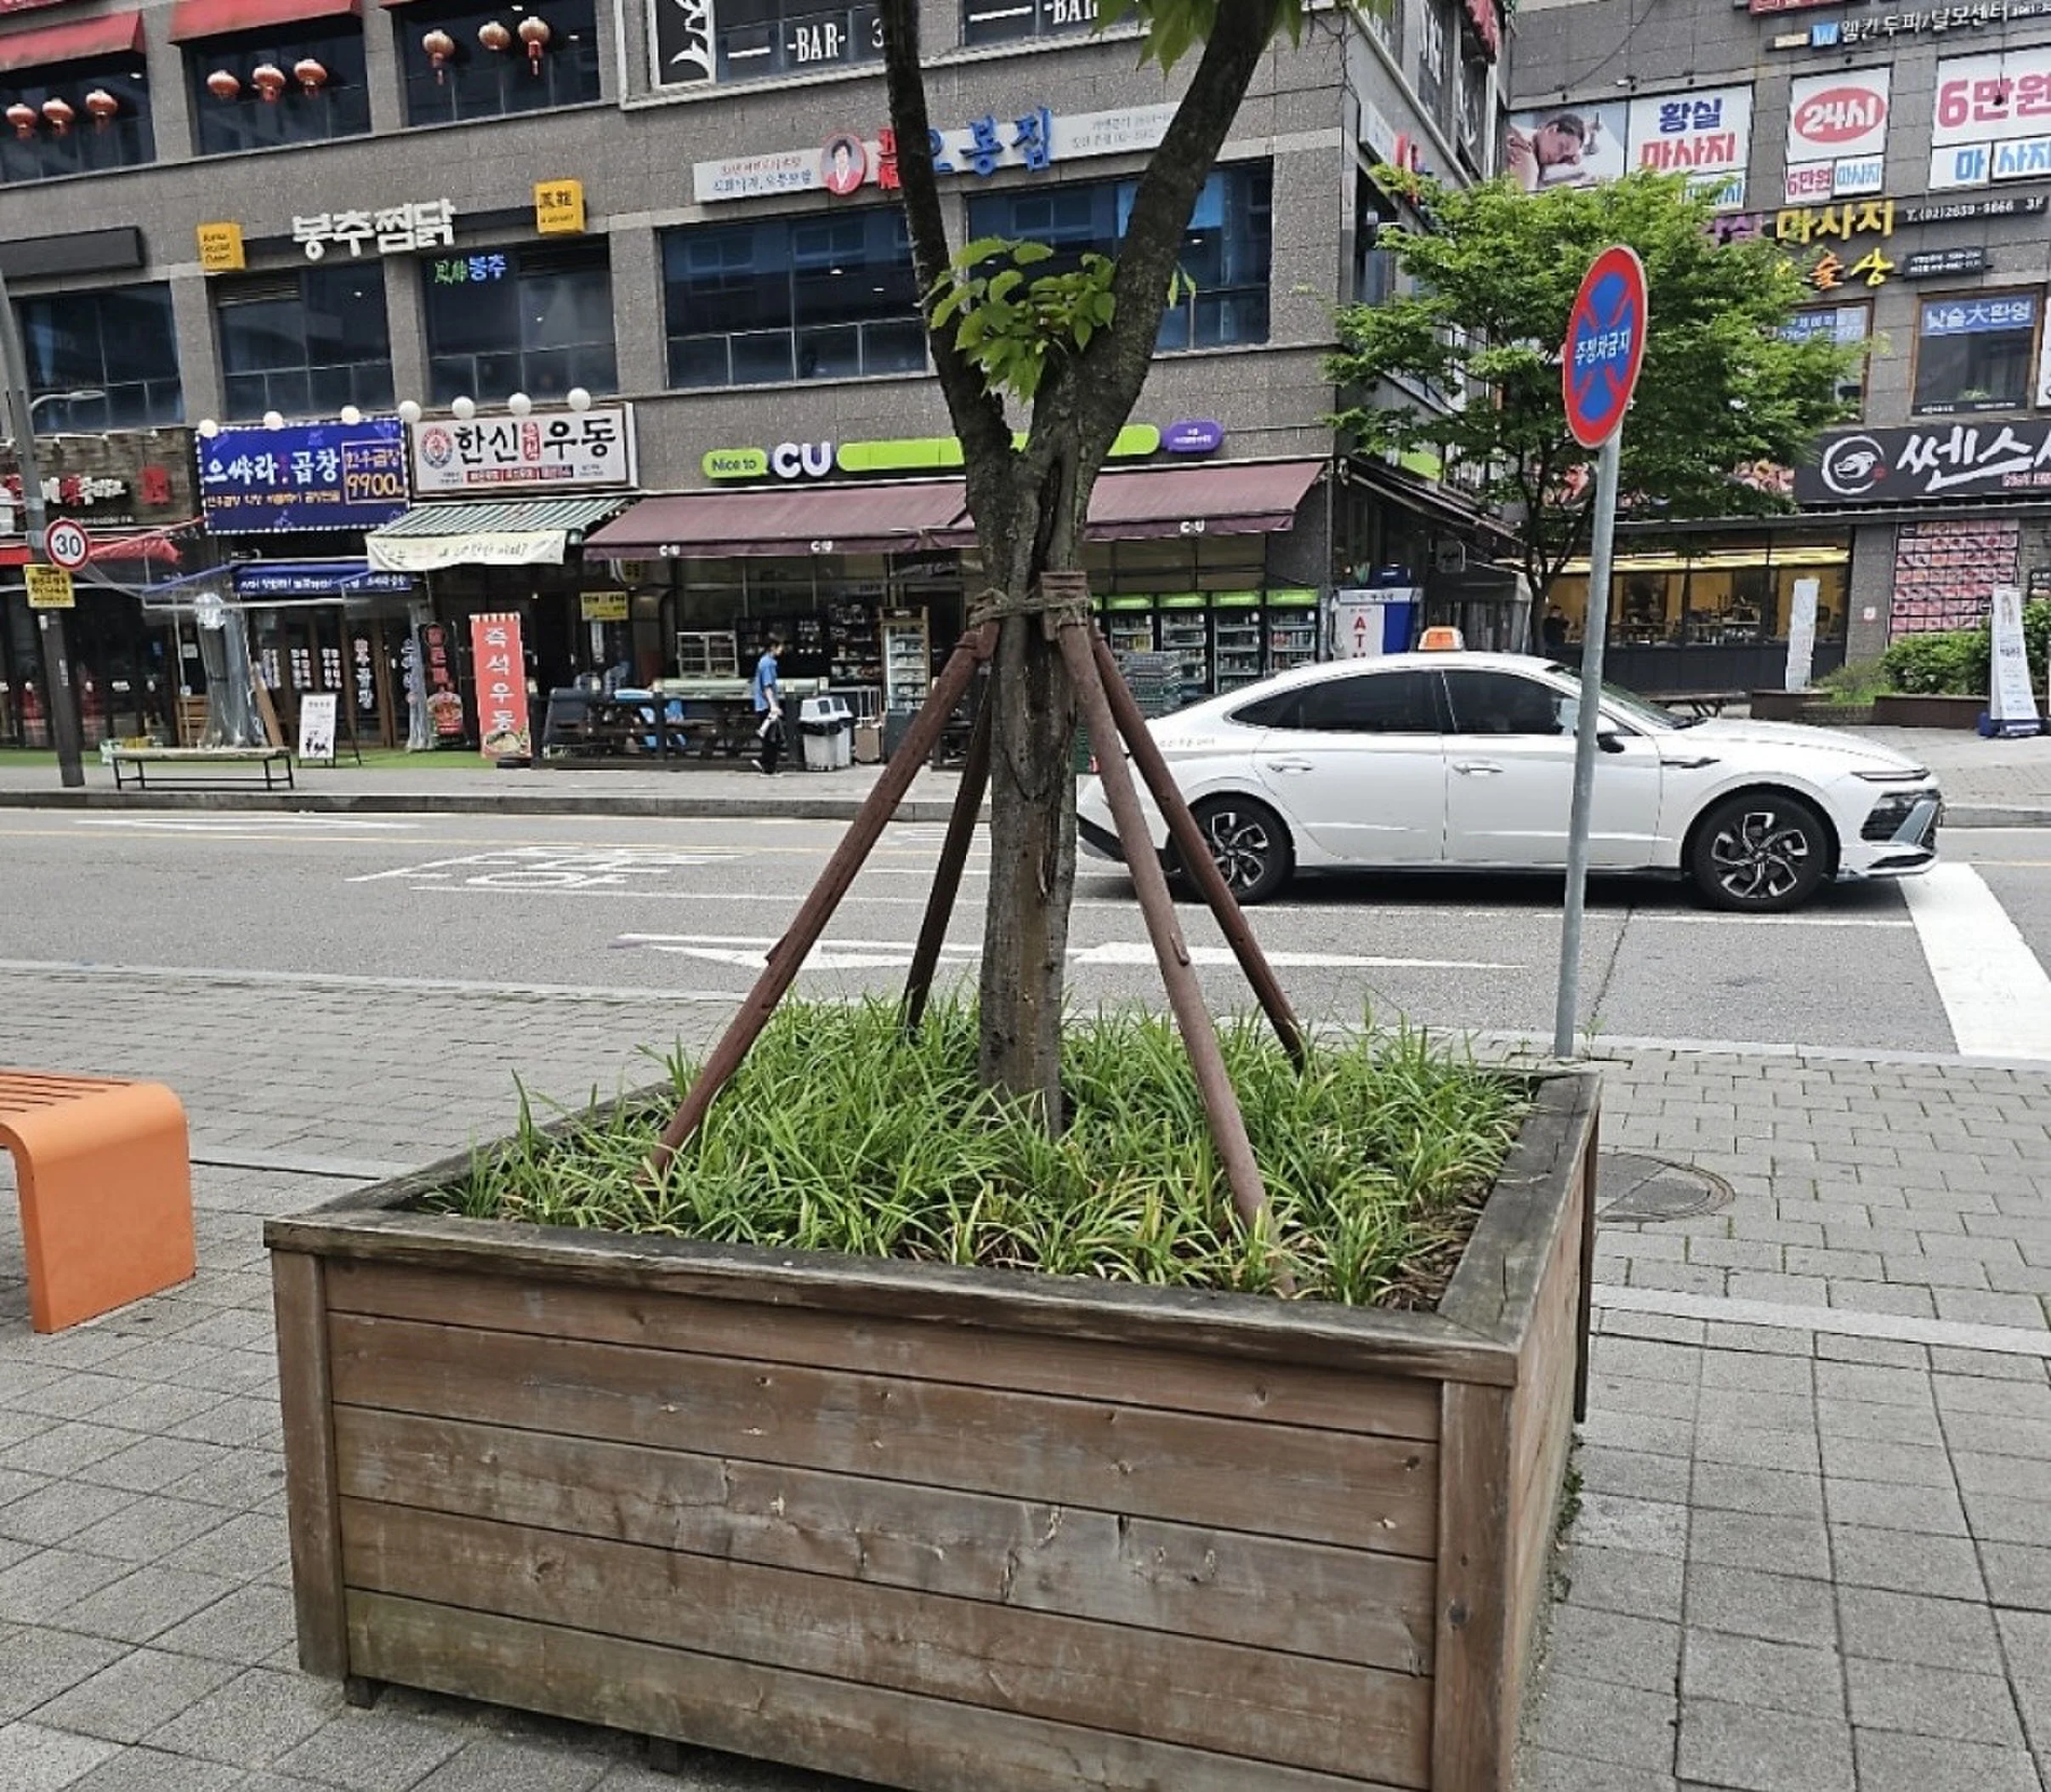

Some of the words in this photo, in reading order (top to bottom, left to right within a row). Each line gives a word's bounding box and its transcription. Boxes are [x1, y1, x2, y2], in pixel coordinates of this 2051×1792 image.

[1659, 97, 1723, 133] 황실
[1802, 98, 1878, 134] 24시
[1641, 132, 1736, 168] 마사지
[1787, 167, 1832, 196] 6만원
[1836, 162, 1882, 185] 마사지
[293, 198, 457, 261] 봉추찜닭
[1776, 199, 1895, 244] 마사지
[1574, 327, 1632, 366] 주정차금지
[454, 422, 520, 465] 한신
[543, 417, 616, 461] 우동
[291, 448, 341, 484] 곱창
[712, 457, 738, 472] Nice
[742, 459, 758, 471] to
[772, 441, 832, 479] CU
[54, 533, 82, 557] 30
